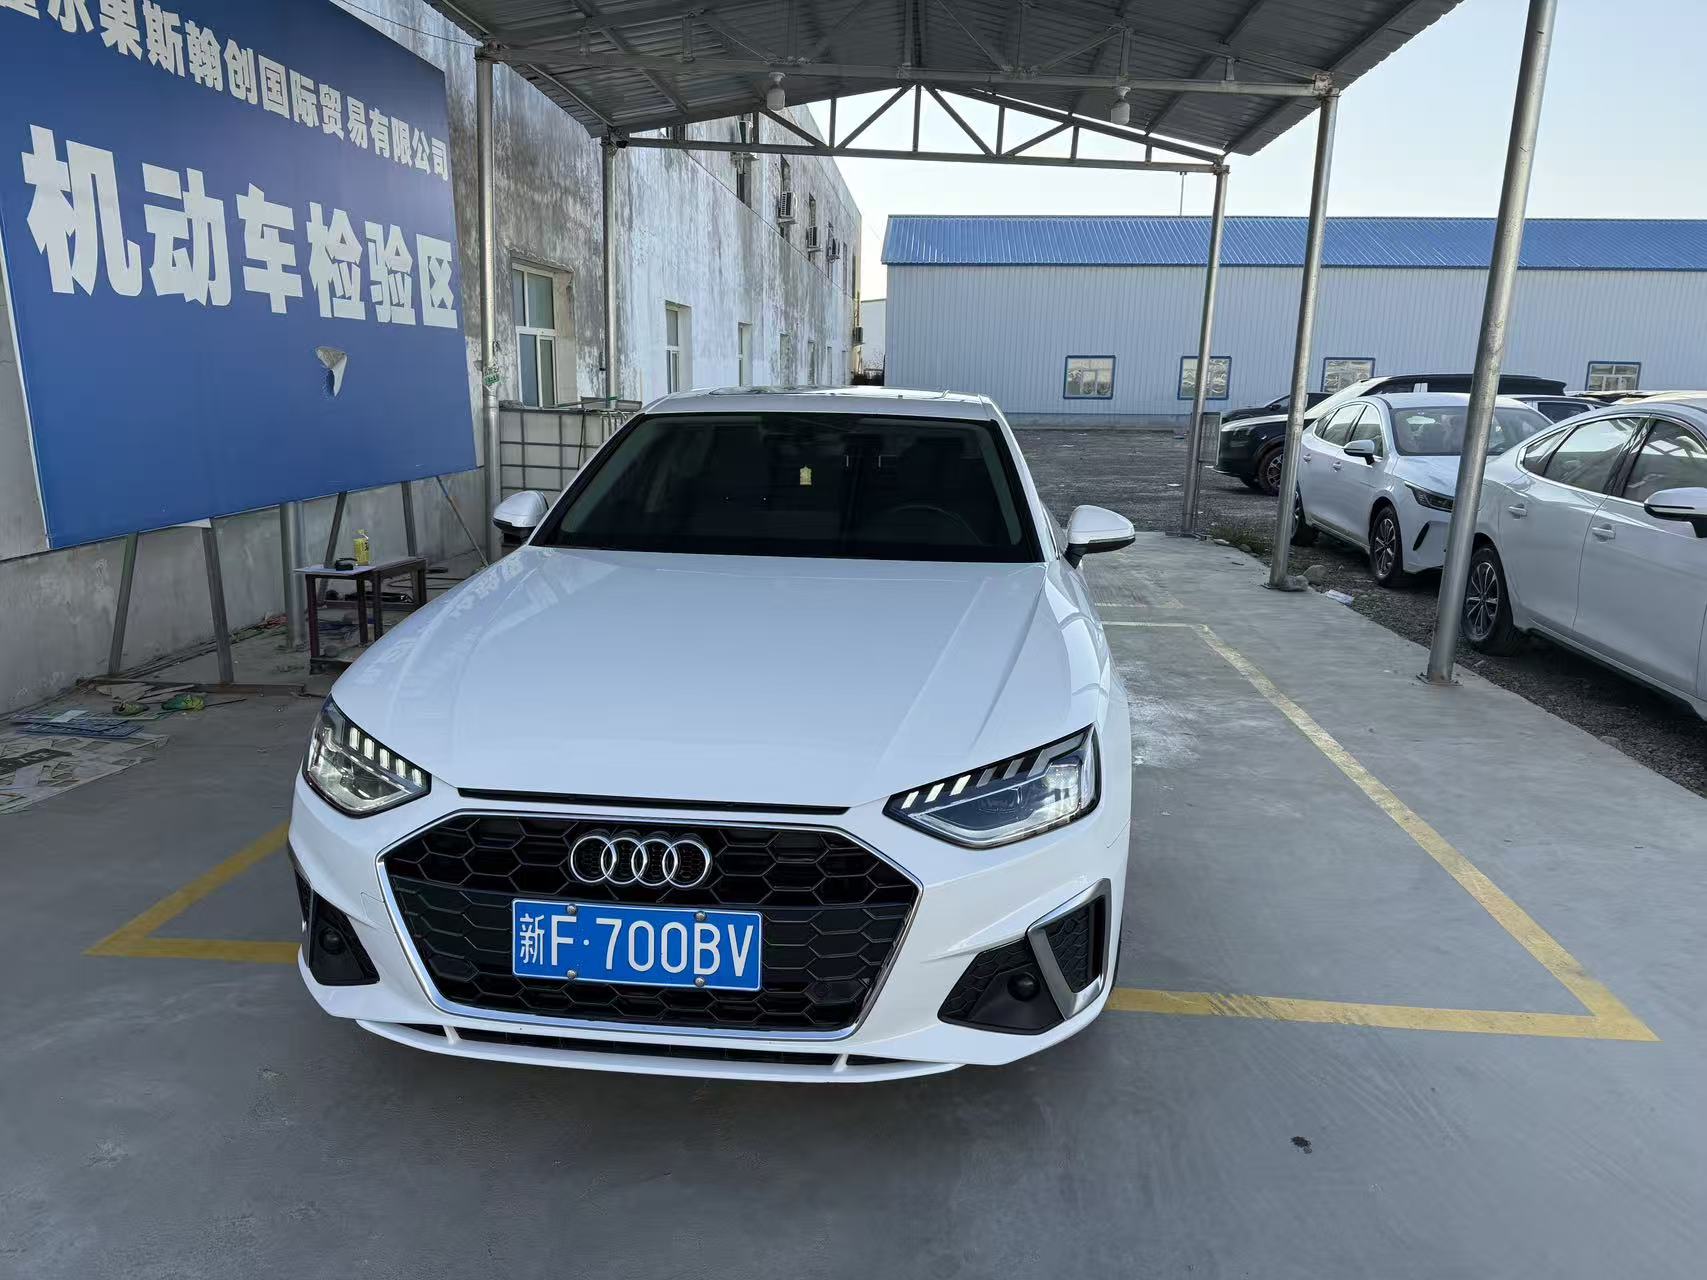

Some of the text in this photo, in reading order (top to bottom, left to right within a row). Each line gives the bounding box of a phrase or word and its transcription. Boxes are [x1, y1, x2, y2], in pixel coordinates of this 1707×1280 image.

[0, 0, 449, 181] 果斯翰创国际贸易有限公司
[21, 124, 458, 329] 机动车检验区
